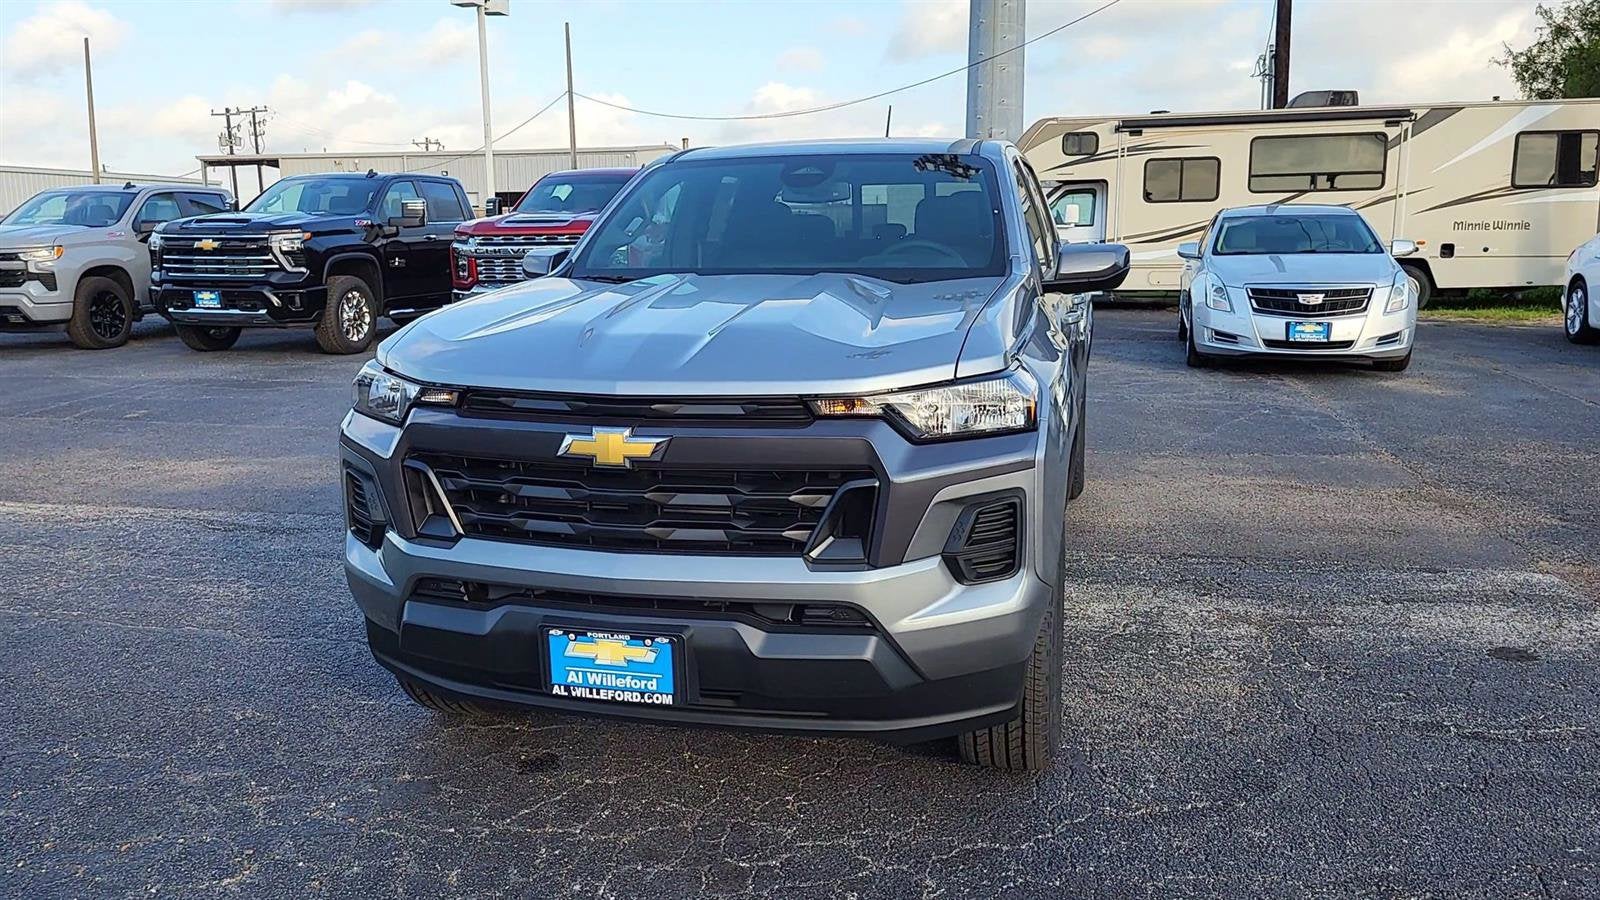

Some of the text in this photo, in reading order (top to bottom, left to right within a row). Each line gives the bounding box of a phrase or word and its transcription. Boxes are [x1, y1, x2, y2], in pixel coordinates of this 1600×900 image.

[1453, 220, 1531, 231] Minnie Winnie
[587, 632, 630, 640] PORTLAND
[567, 671, 657, 690] Al Willeford
[552, 685, 673, 705] AL WILLEFORD.COM
